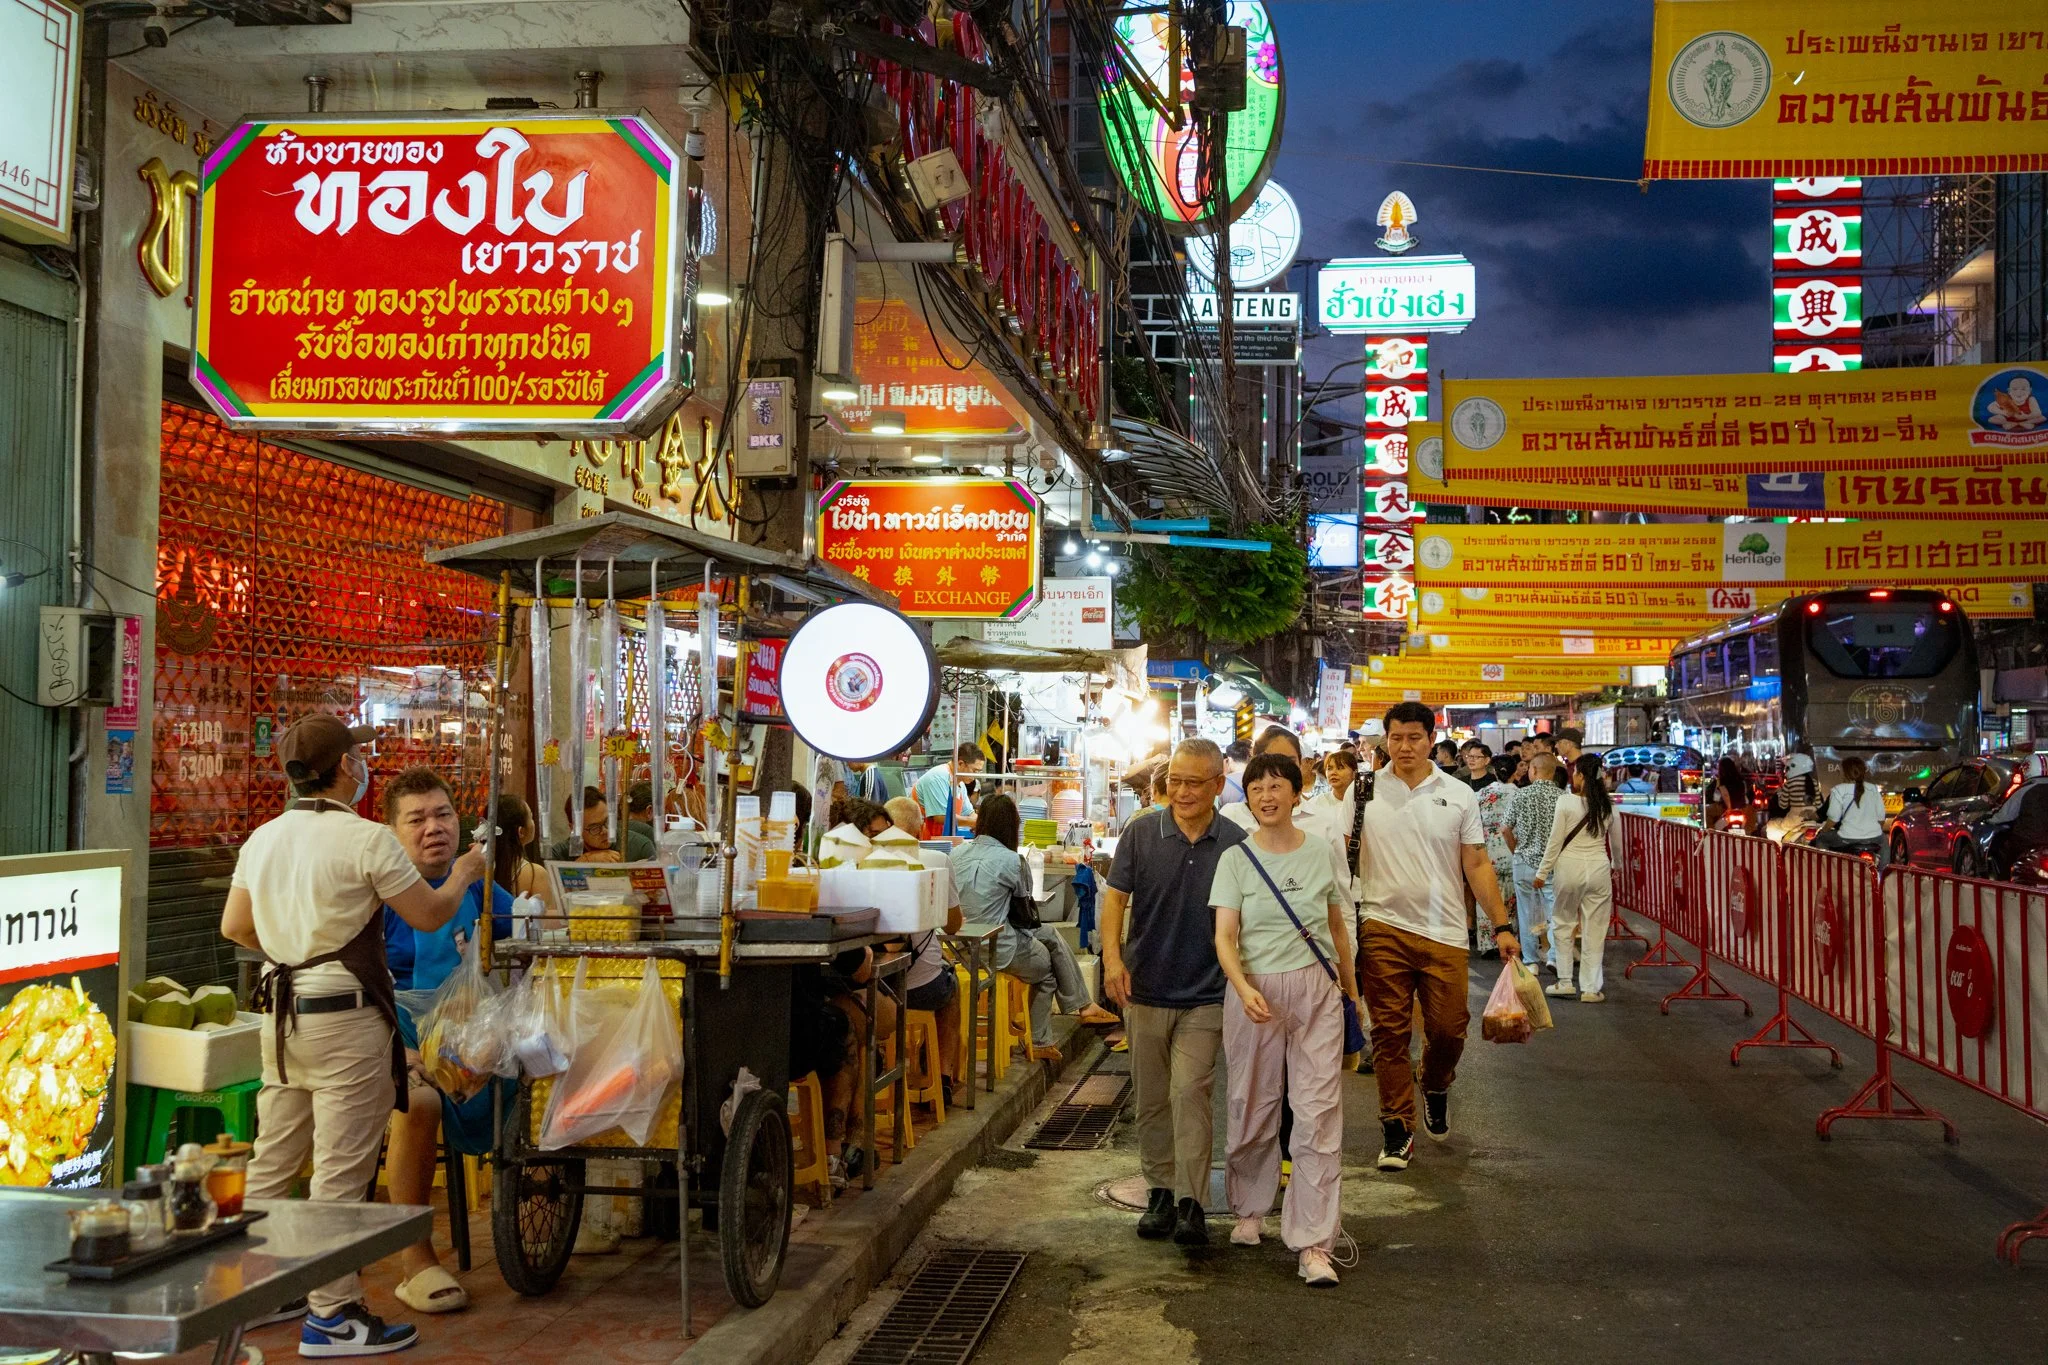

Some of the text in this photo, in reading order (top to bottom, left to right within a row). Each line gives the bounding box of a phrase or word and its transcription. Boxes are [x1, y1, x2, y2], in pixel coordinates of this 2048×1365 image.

[1785, 23, 2048, 55] ประเพณีงานเจ เยา
[1777, 74, 2048, 125] ความสัมพันธ
[265, 131, 444, 165] ห้างขายทอง
[292, 126, 590, 237] ทองใบ
[462, 229, 642, 274] เยาวราช
[229, 276, 345, 315] จำหน่าย
[1326, 281, 1464, 319] ฮั่วเซ่งเฮง
[1190, 299, 1291, 317] LATENG
[294, 319, 591, 369] รับซื้อทองเก่าทุกชนิด
[1522, 393, 1647, 413] ประเพณีงานเจ
[1653, 395, 1727, 410] เยาวราช
[1808, 389, 1876, 411] ตุลาคม
[750, 435, 780, 446] BKK
[1521, 413, 1939, 452] ความสัมพันธ์ที่ดี 50 ปี ไทย-จีน
[1303, 471, 1350, 486] GOLD
[838, 494, 870, 507] บริษัท
[884, 507, 942, 532] ทาวน์
[996, 531, 1028, 542] จำกัด
[1639, 535, 1680, 549] ตุลาคม
[899, 541, 1027, 560] เงินตราต่างประเทศ
[1462, 549, 1716, 572] ความสัมพันธ์ที่ดี 50 ปี ไทย-จีน
[1725, 552, 1782, 566] Heritage
[914, 590, 1011, 605] EXCHANGE
[1494, 588, 1600, 606] ความสัมพันธ์ที่ดี
[1606, 594, 1627, 606] 50
[1644, 590, 1697, 608] ไทย-จีน
[0, 889, 79, 945] ทาวน์
